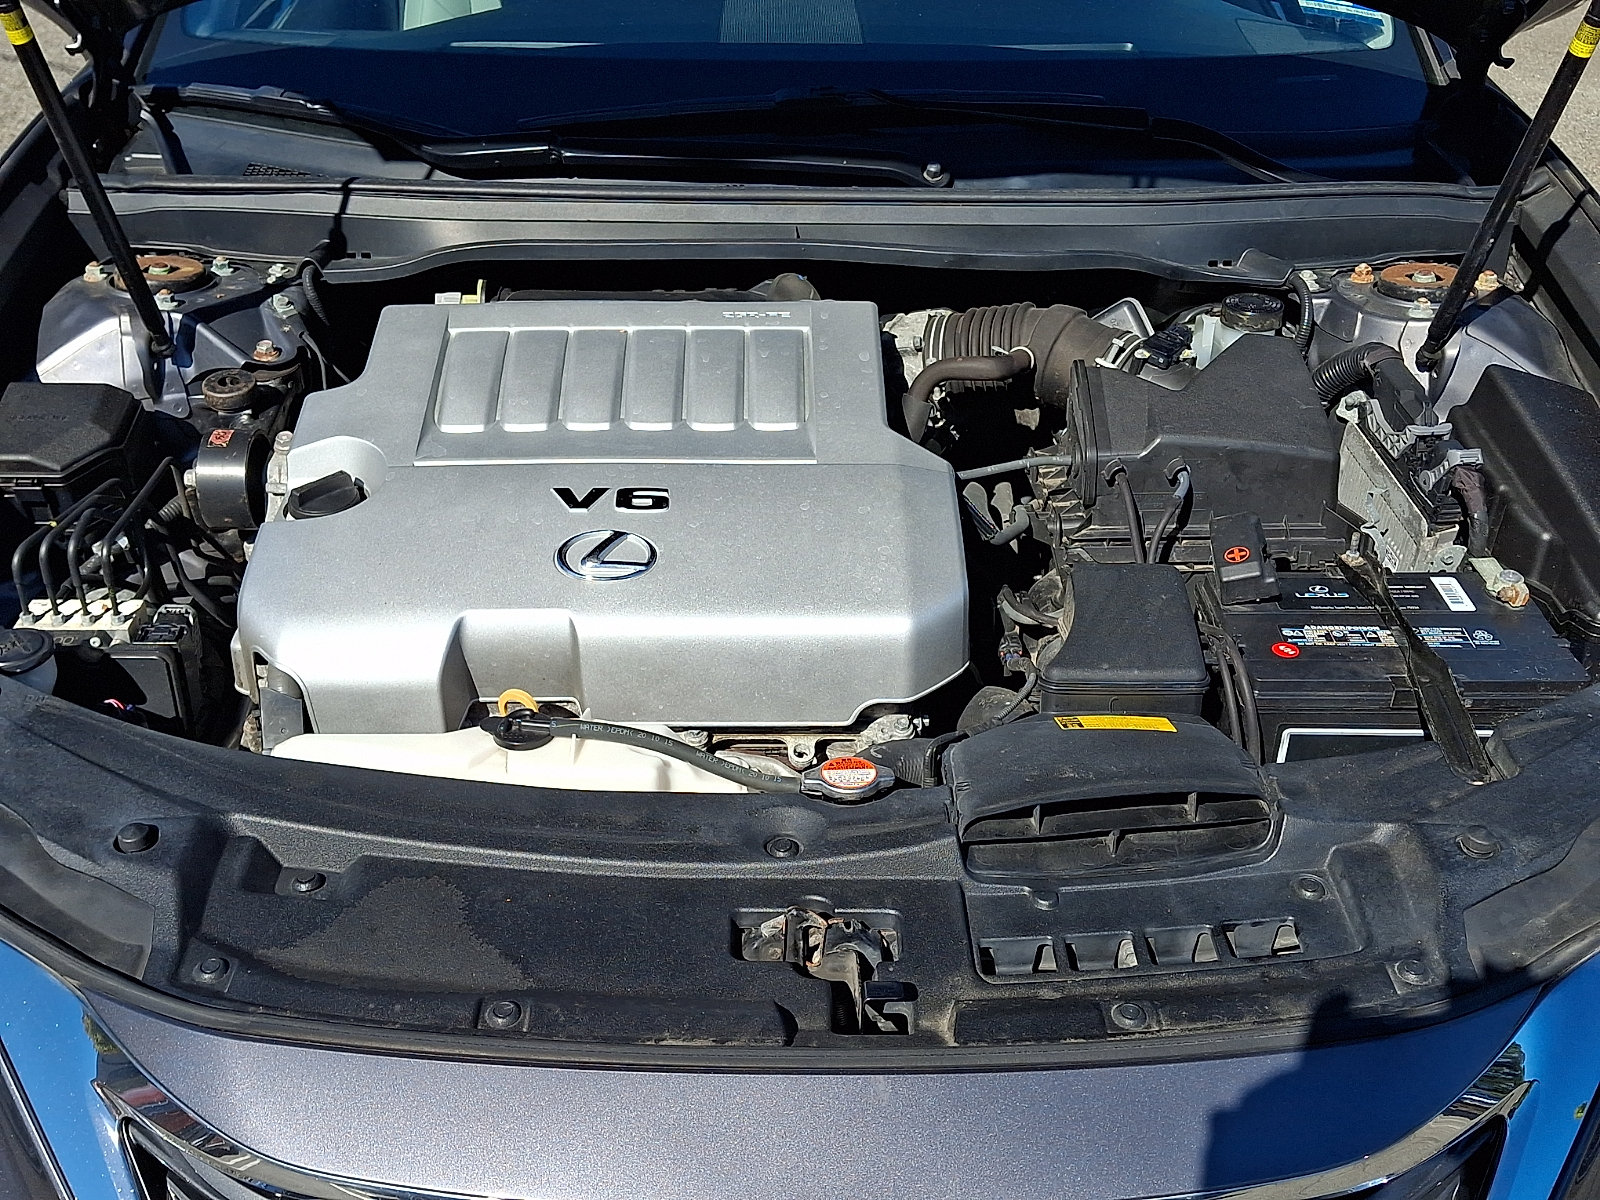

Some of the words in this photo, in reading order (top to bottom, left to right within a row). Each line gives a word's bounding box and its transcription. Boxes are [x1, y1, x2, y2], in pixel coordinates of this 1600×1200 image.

[550, 486, 671, 513] V6
[580, 722, 604, 732] WATER
[651, 734, 660, 742] 10
[664, 739, 674, 747] 15
[695, 750, 719, 764] WATER
[748, 770, 758, 778] 20
[761, 773, 770, 781] 10
[773, 775, 782, 783] 15
